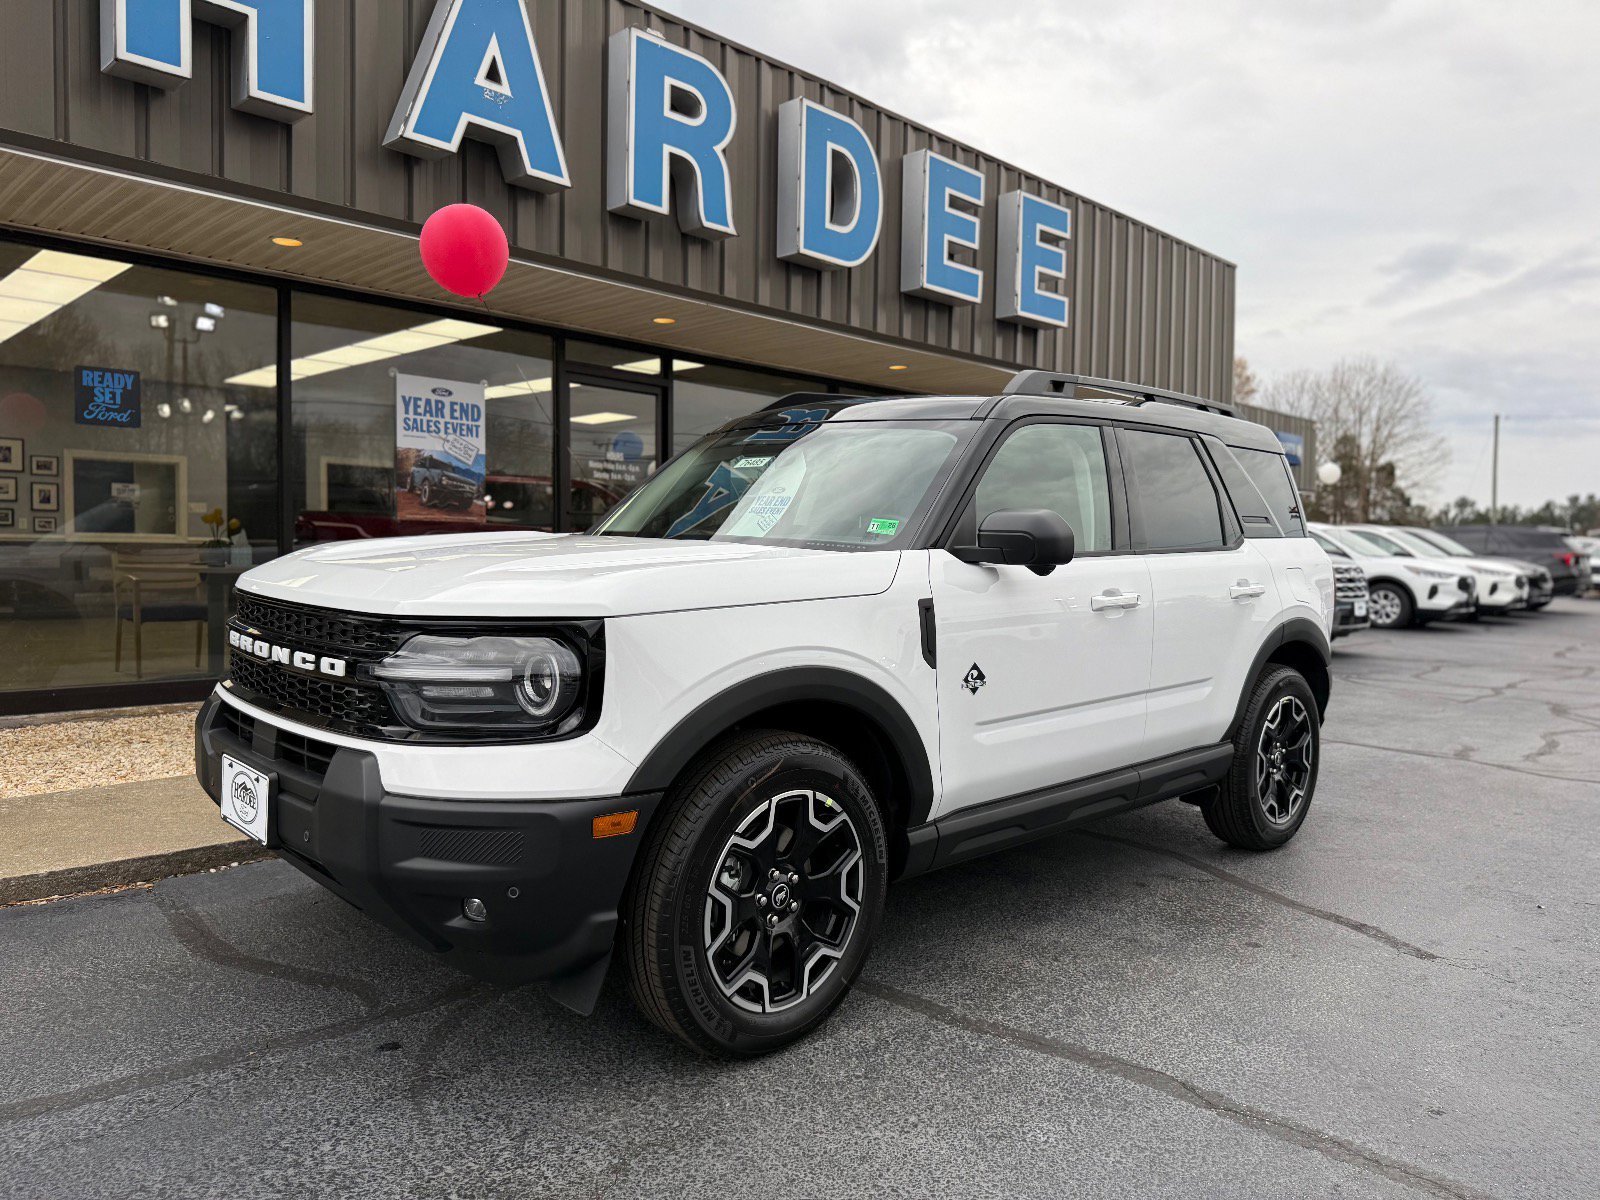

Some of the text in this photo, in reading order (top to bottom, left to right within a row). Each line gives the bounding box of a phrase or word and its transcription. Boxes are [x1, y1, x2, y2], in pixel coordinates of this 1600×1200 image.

[82, 369, 134, 390] READY
[93, 386, 123, 404] SET
[83, 402, 132, 422] Ford
[401, 395, 481, 422] YEAR END
[403, 417, 480, 438] SALES EVENT
[229, 629, 346, 677] BRONCO
[860, 793, 886, 861] MICHELIN
[682, 950, 715, 1022] MICHELIN
